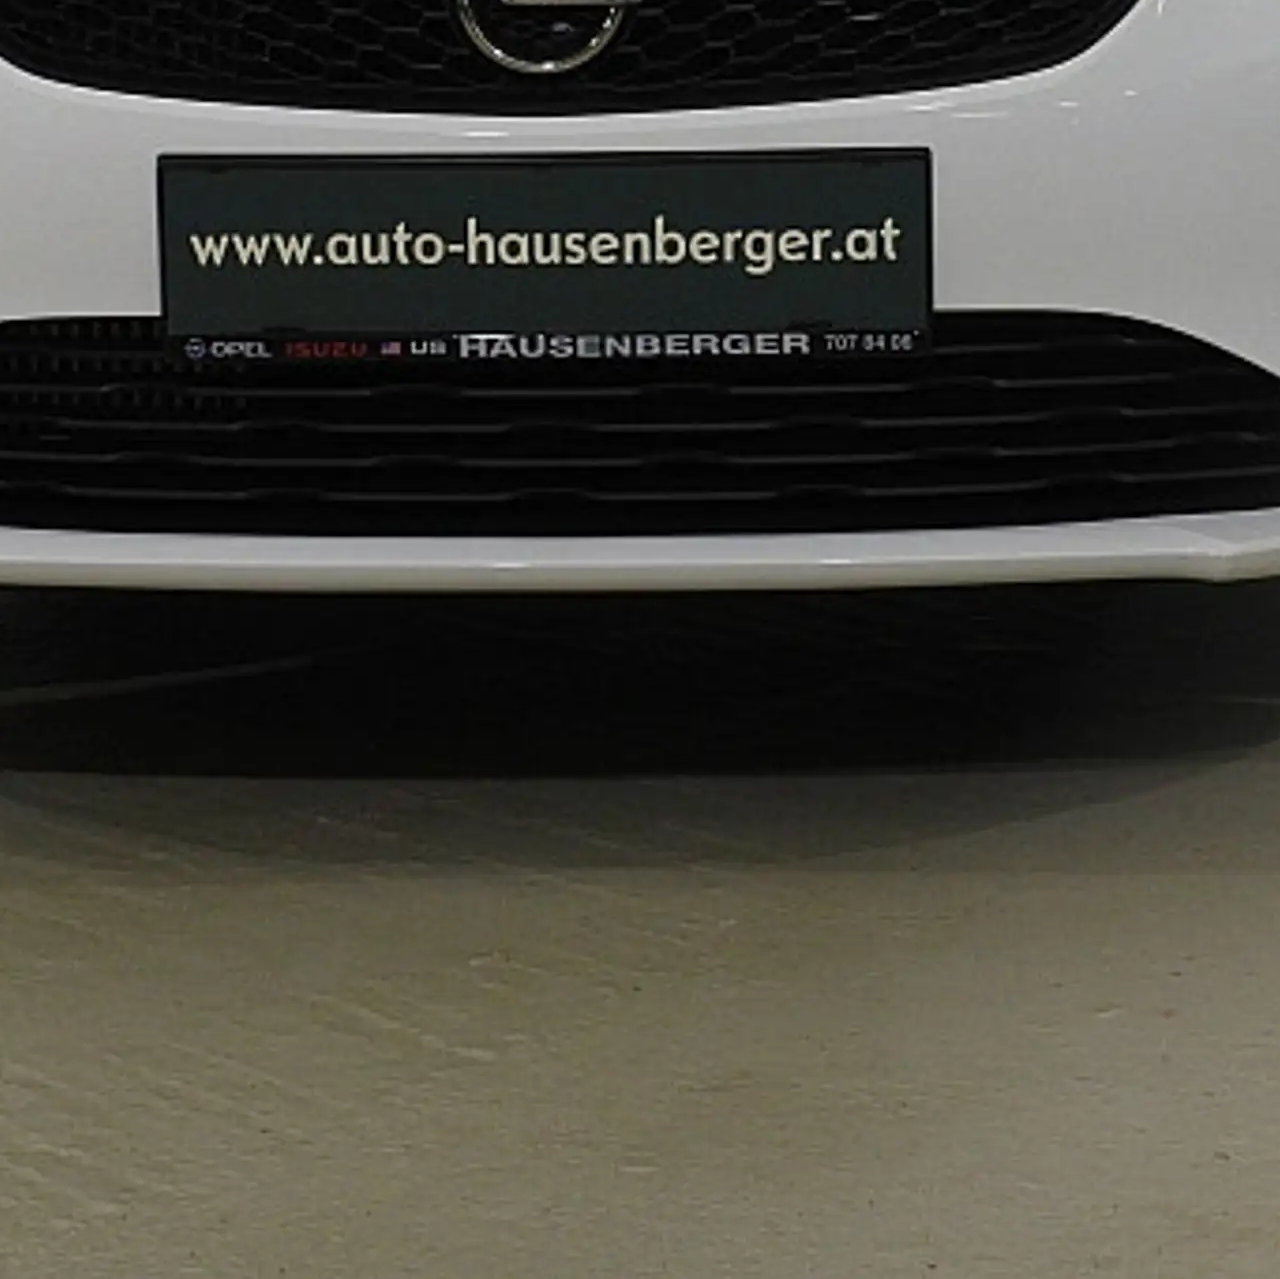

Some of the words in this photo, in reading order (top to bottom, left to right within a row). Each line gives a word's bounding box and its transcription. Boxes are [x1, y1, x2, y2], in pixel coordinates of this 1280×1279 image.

[189, 214, 902, 275] www.auto-hausenberger.at
[210, 340, 272, 359] OPEL
[286, 340, 368, 359] ISUZU
[459, 333, 811, 359] HAUSENBERGER
